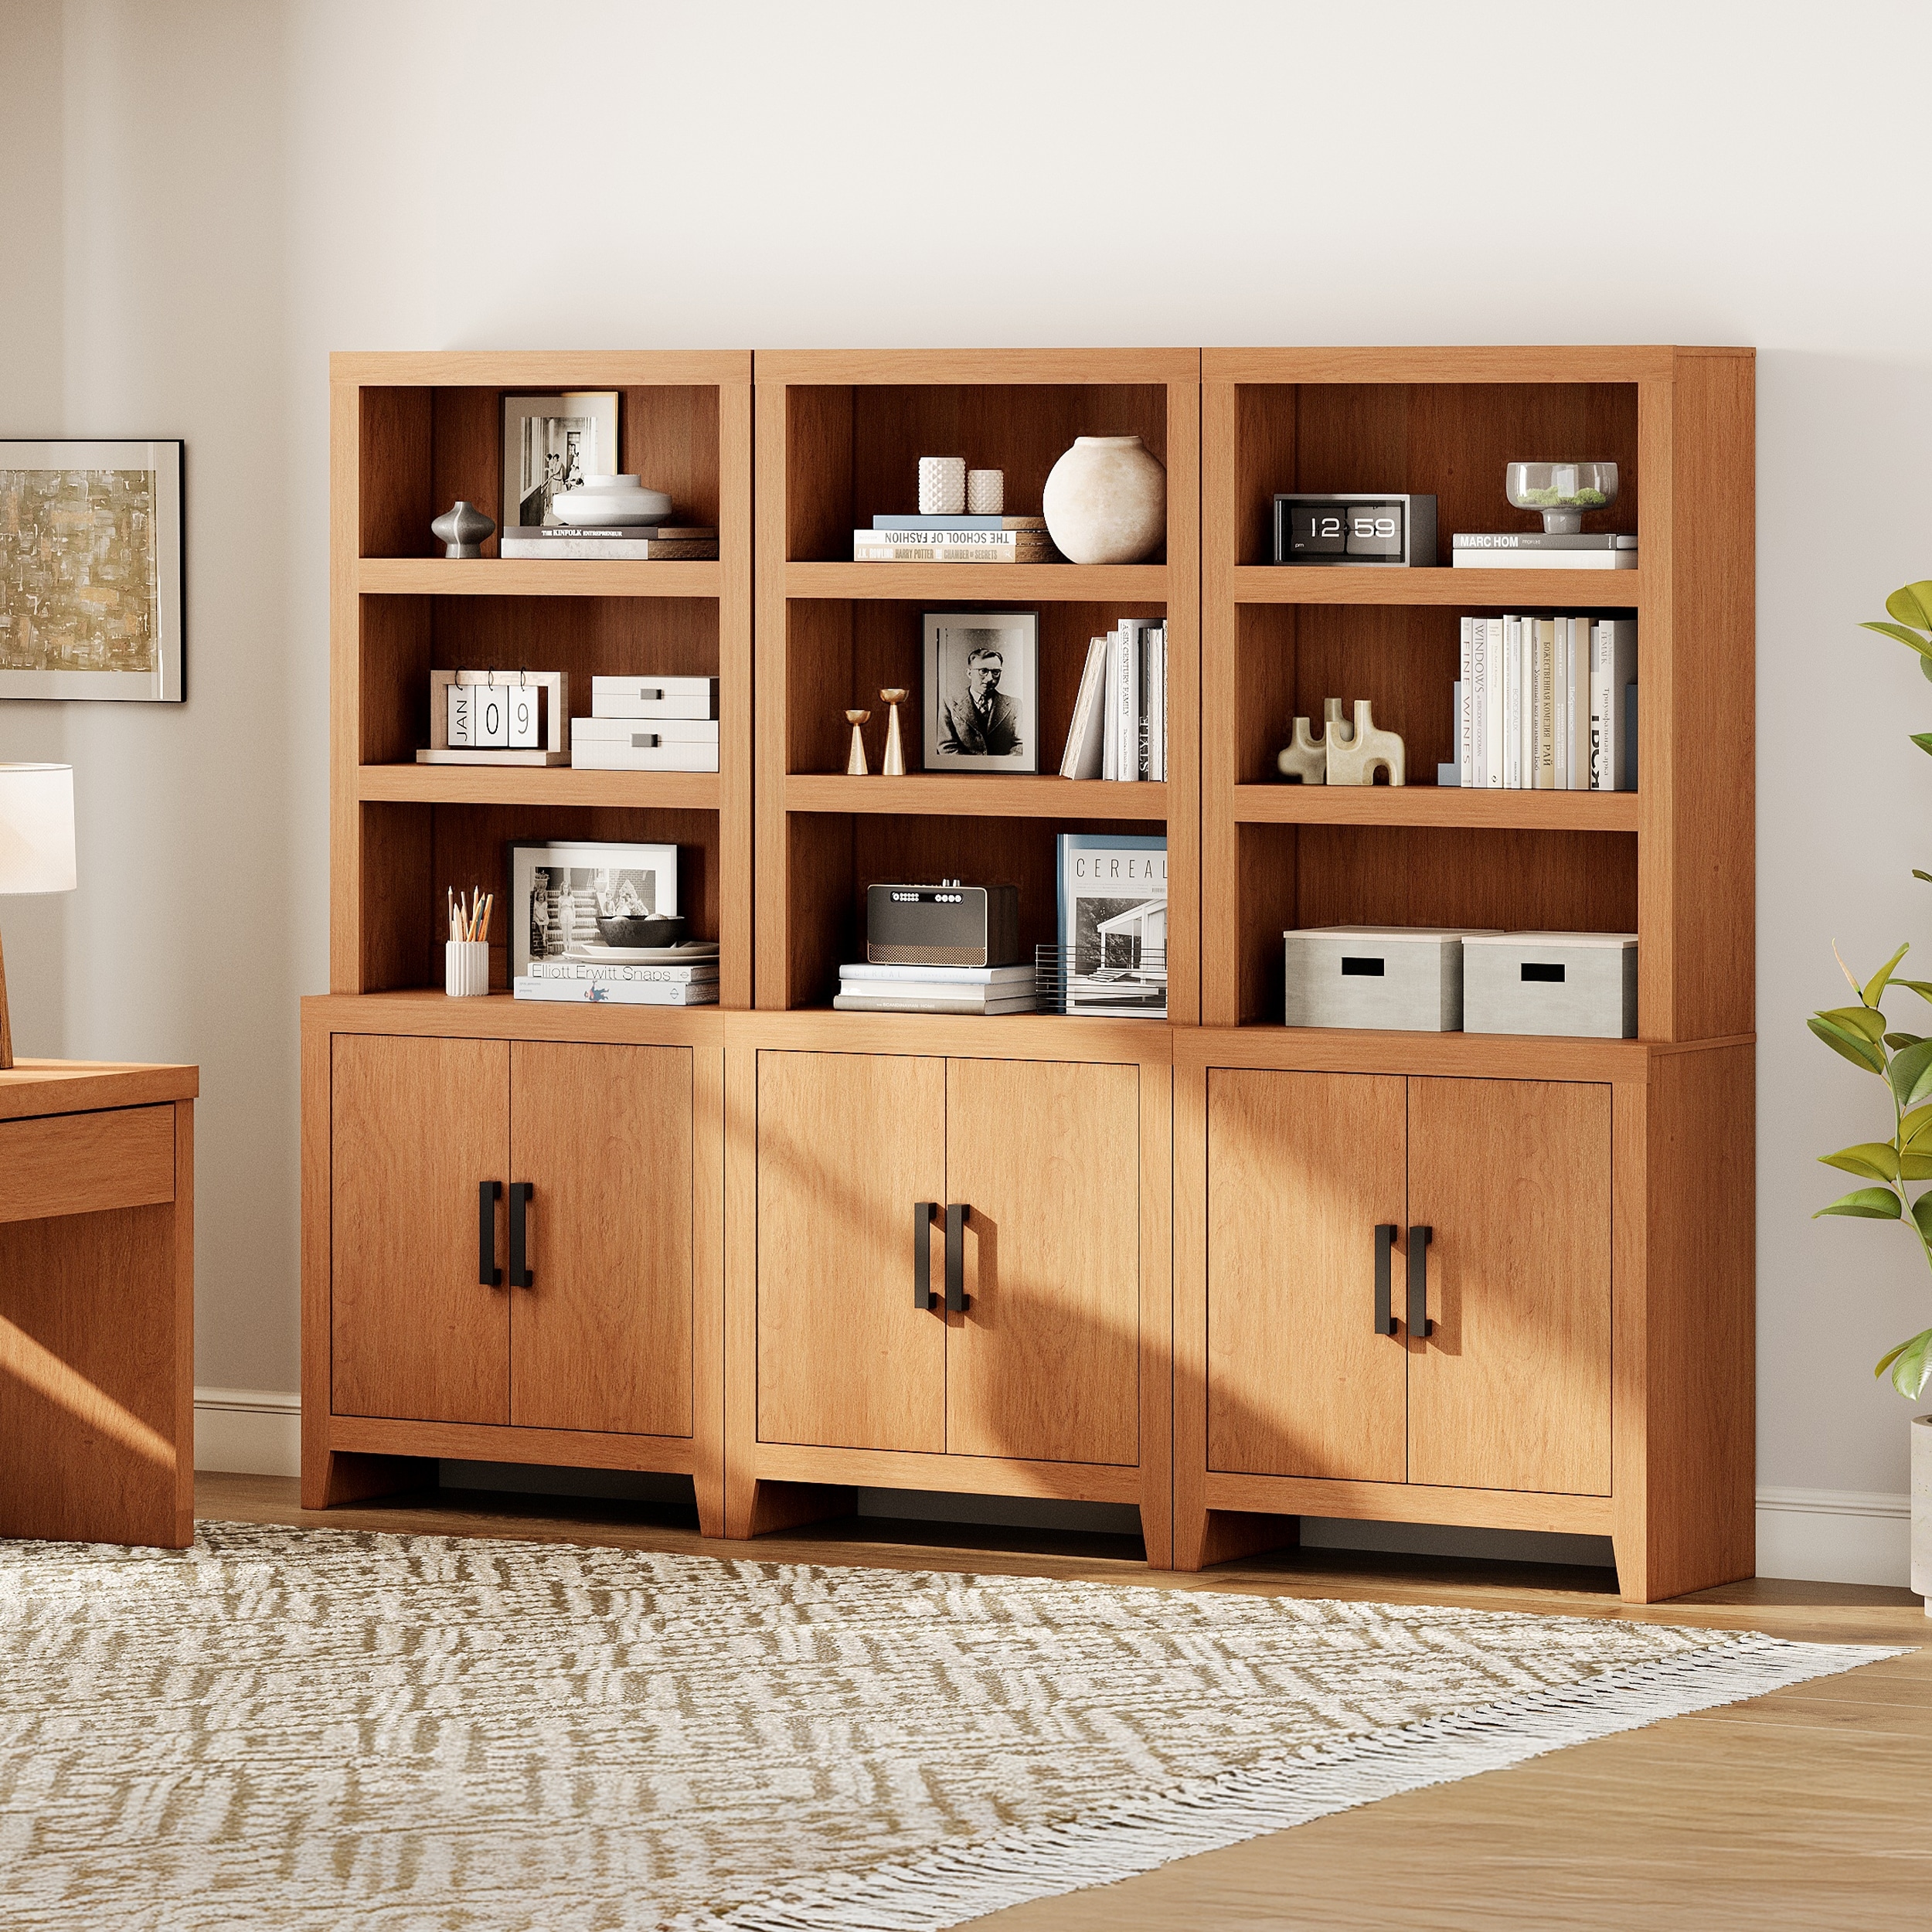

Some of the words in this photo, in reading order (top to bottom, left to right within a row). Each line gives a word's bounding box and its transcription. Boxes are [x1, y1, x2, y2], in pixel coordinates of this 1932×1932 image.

[1311, 518, 1340, 537] 12
[1354, 518, 1396, 538] 59
[885, 532, 927, 543] FASHION
[932, 532, 944, 543] OF
[947, 532, 987, 543] SCHOOL
[991, 532, 1009, 543] THE
[1460, 536, 1492, 547] MARC
[1493, 536, 1519, 547] HOM
[857, 548, 868, 559] J.K.
[869, 548, 893, 559] ROWLING
[895, 549, 913, 559] HARRY
[913, 549, 934, 560] POTTER
[944, 549, 970, 560] CHAMBER
[975, 549, 998, 560] SECRETS
[1122, 623, 1129, 632] A
[1475, 624, 1485, 692] WINDOWS
[457, 700, 468, 741] JAN
[1535, 719, 1539, 729] по
[1139, 716, 1149, 773] STYLE
[1543, 744, 1553, 767] РАЙ
[1077, 858, 1168, 879] CEREAL
[532, 964, 570, 978] Elliott
[577, 965, 617, 980] Erwitt
[622, 966, 671, 981] Snaps
[854, 969, 903, 978] CEREAL
